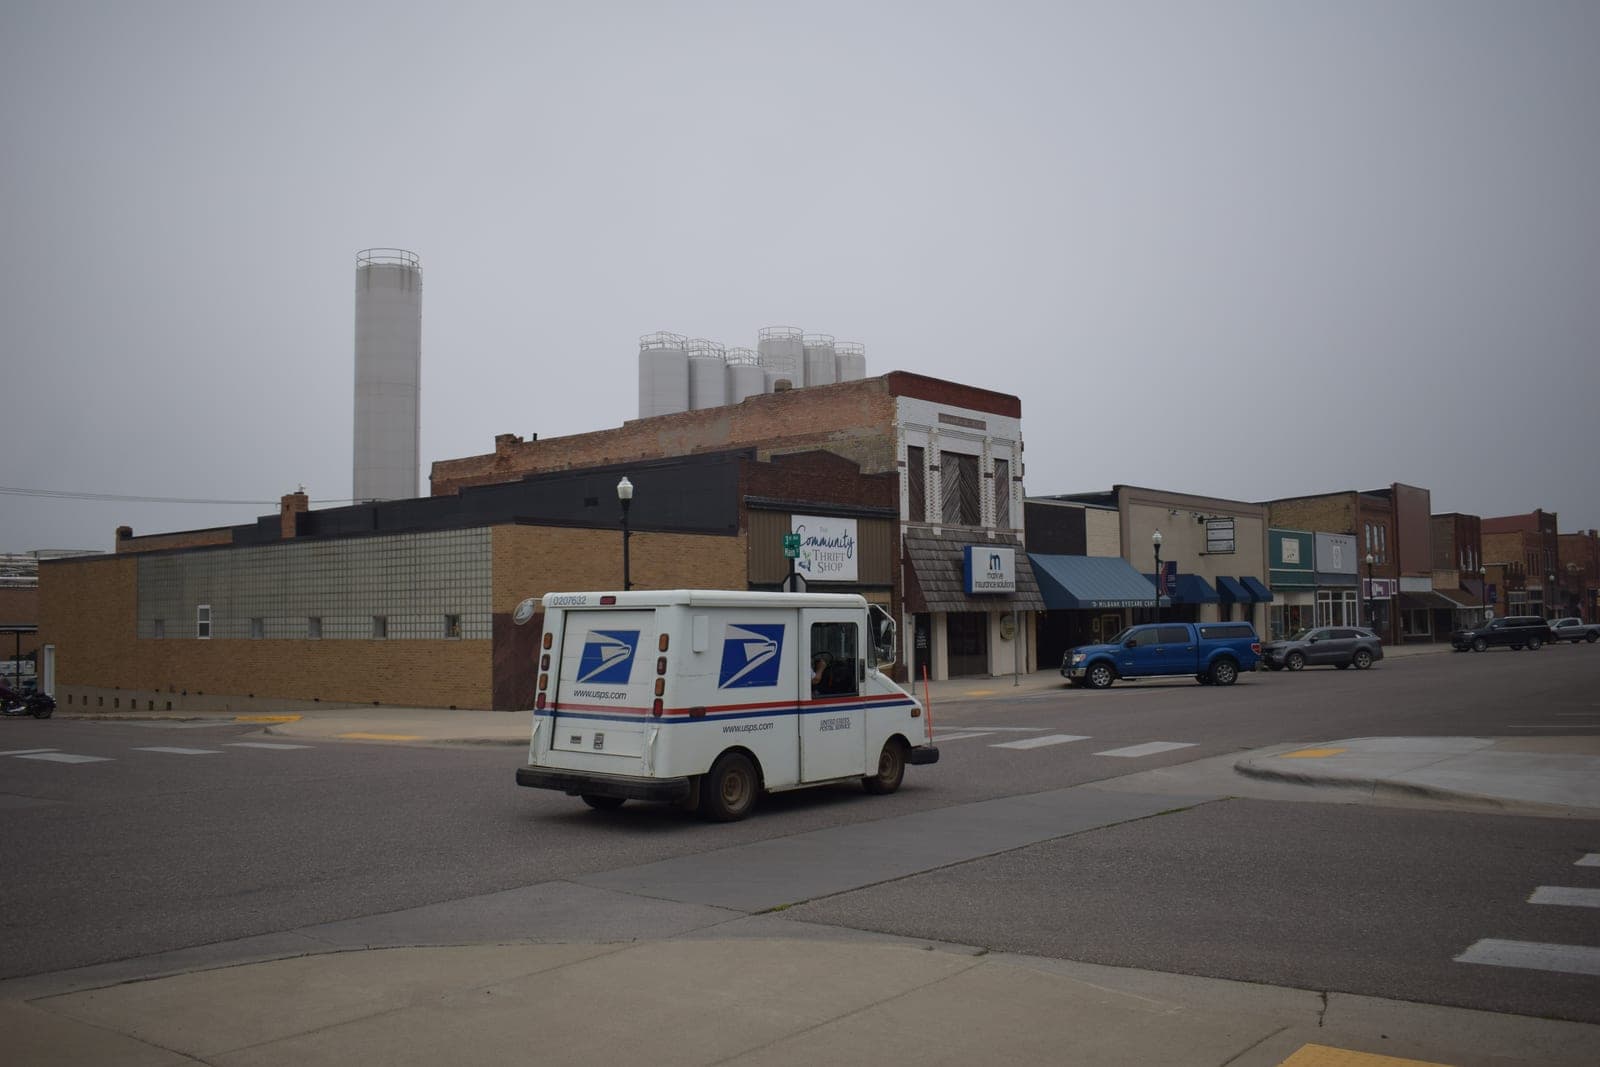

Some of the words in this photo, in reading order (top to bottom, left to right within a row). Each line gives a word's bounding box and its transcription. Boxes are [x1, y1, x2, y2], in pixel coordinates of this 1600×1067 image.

[796, 525, 855, 559] Community
[813, 550, 846, 561] THRIFT
[818, 562, 843, 573] SHOP
[573, 689, 627, 700] www.usps.com
[722, 721, 774, 734] www.usps.com
